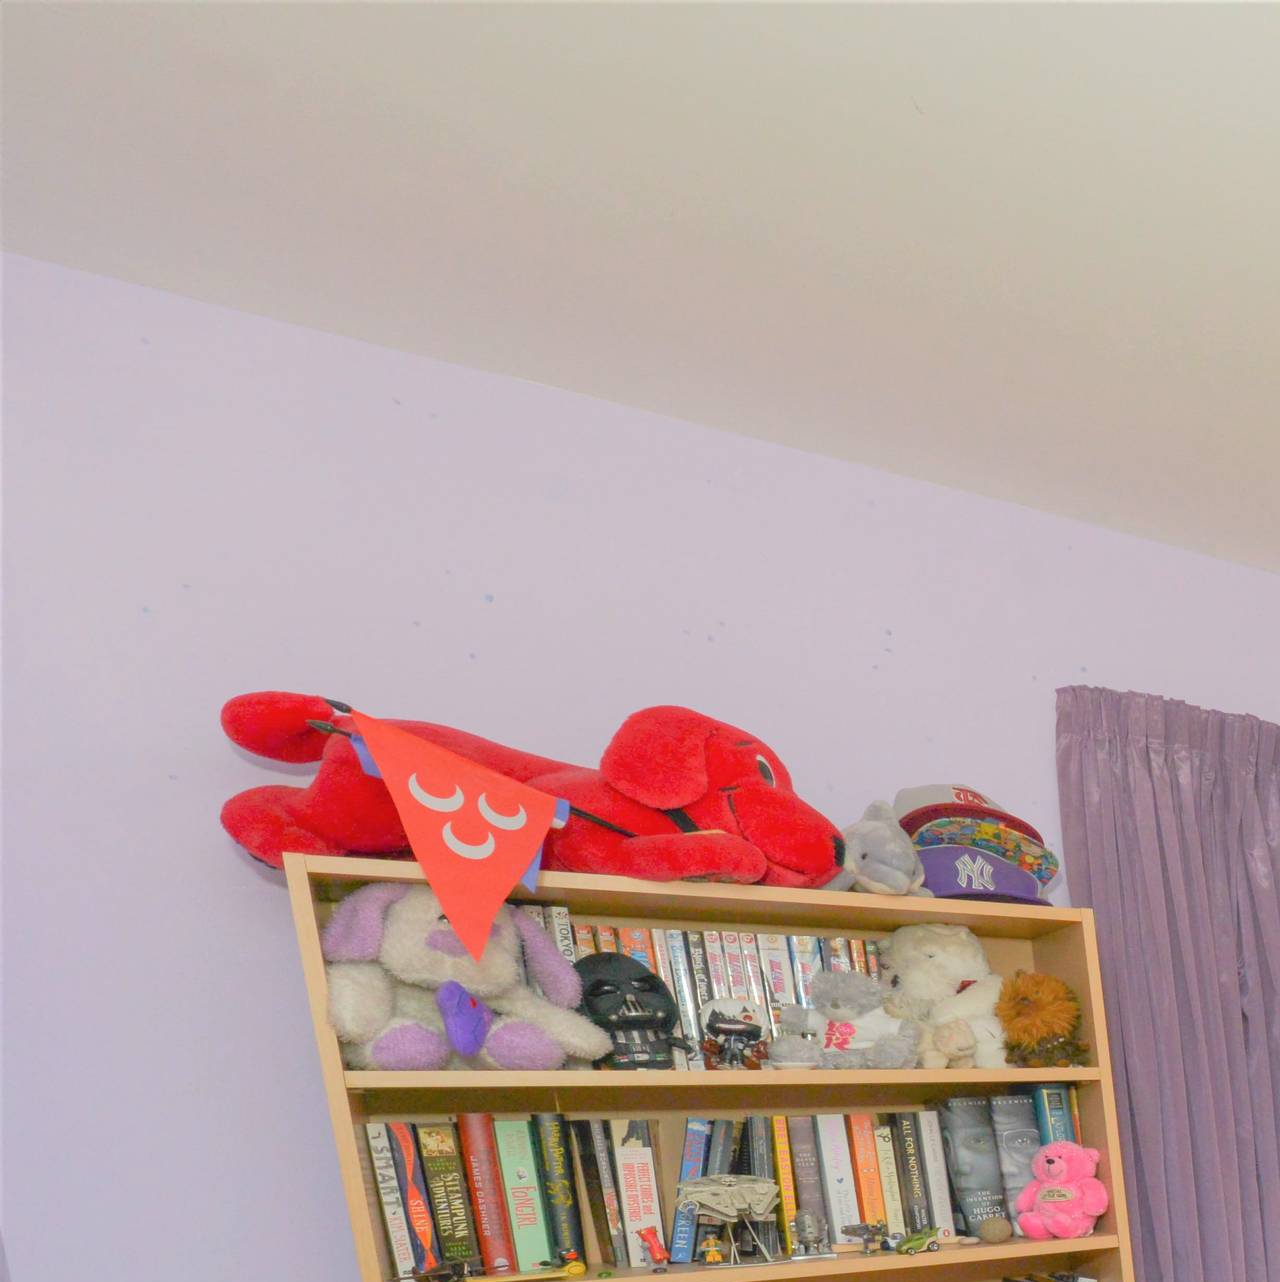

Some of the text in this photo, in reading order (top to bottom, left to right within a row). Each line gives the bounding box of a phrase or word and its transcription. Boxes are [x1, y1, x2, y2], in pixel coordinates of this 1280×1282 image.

[558, 921, 573, 957] TOKYO
[776, 1119, 787, 1147] BRET
[902, 1120, 922, 1198] ALL FOR NOTHING
[373, 1145, 401, 1208] SMART
[470, 1155, 491, 1236] JAMES DASHNER
[409, 1199, 429, 1233] SHINE
[430, 1180, 452, 1236] ADVENTURES
[440, 1173, 469, 1238] STEAMPUNK
[973, 1206, 1001, 1215] HUGO
